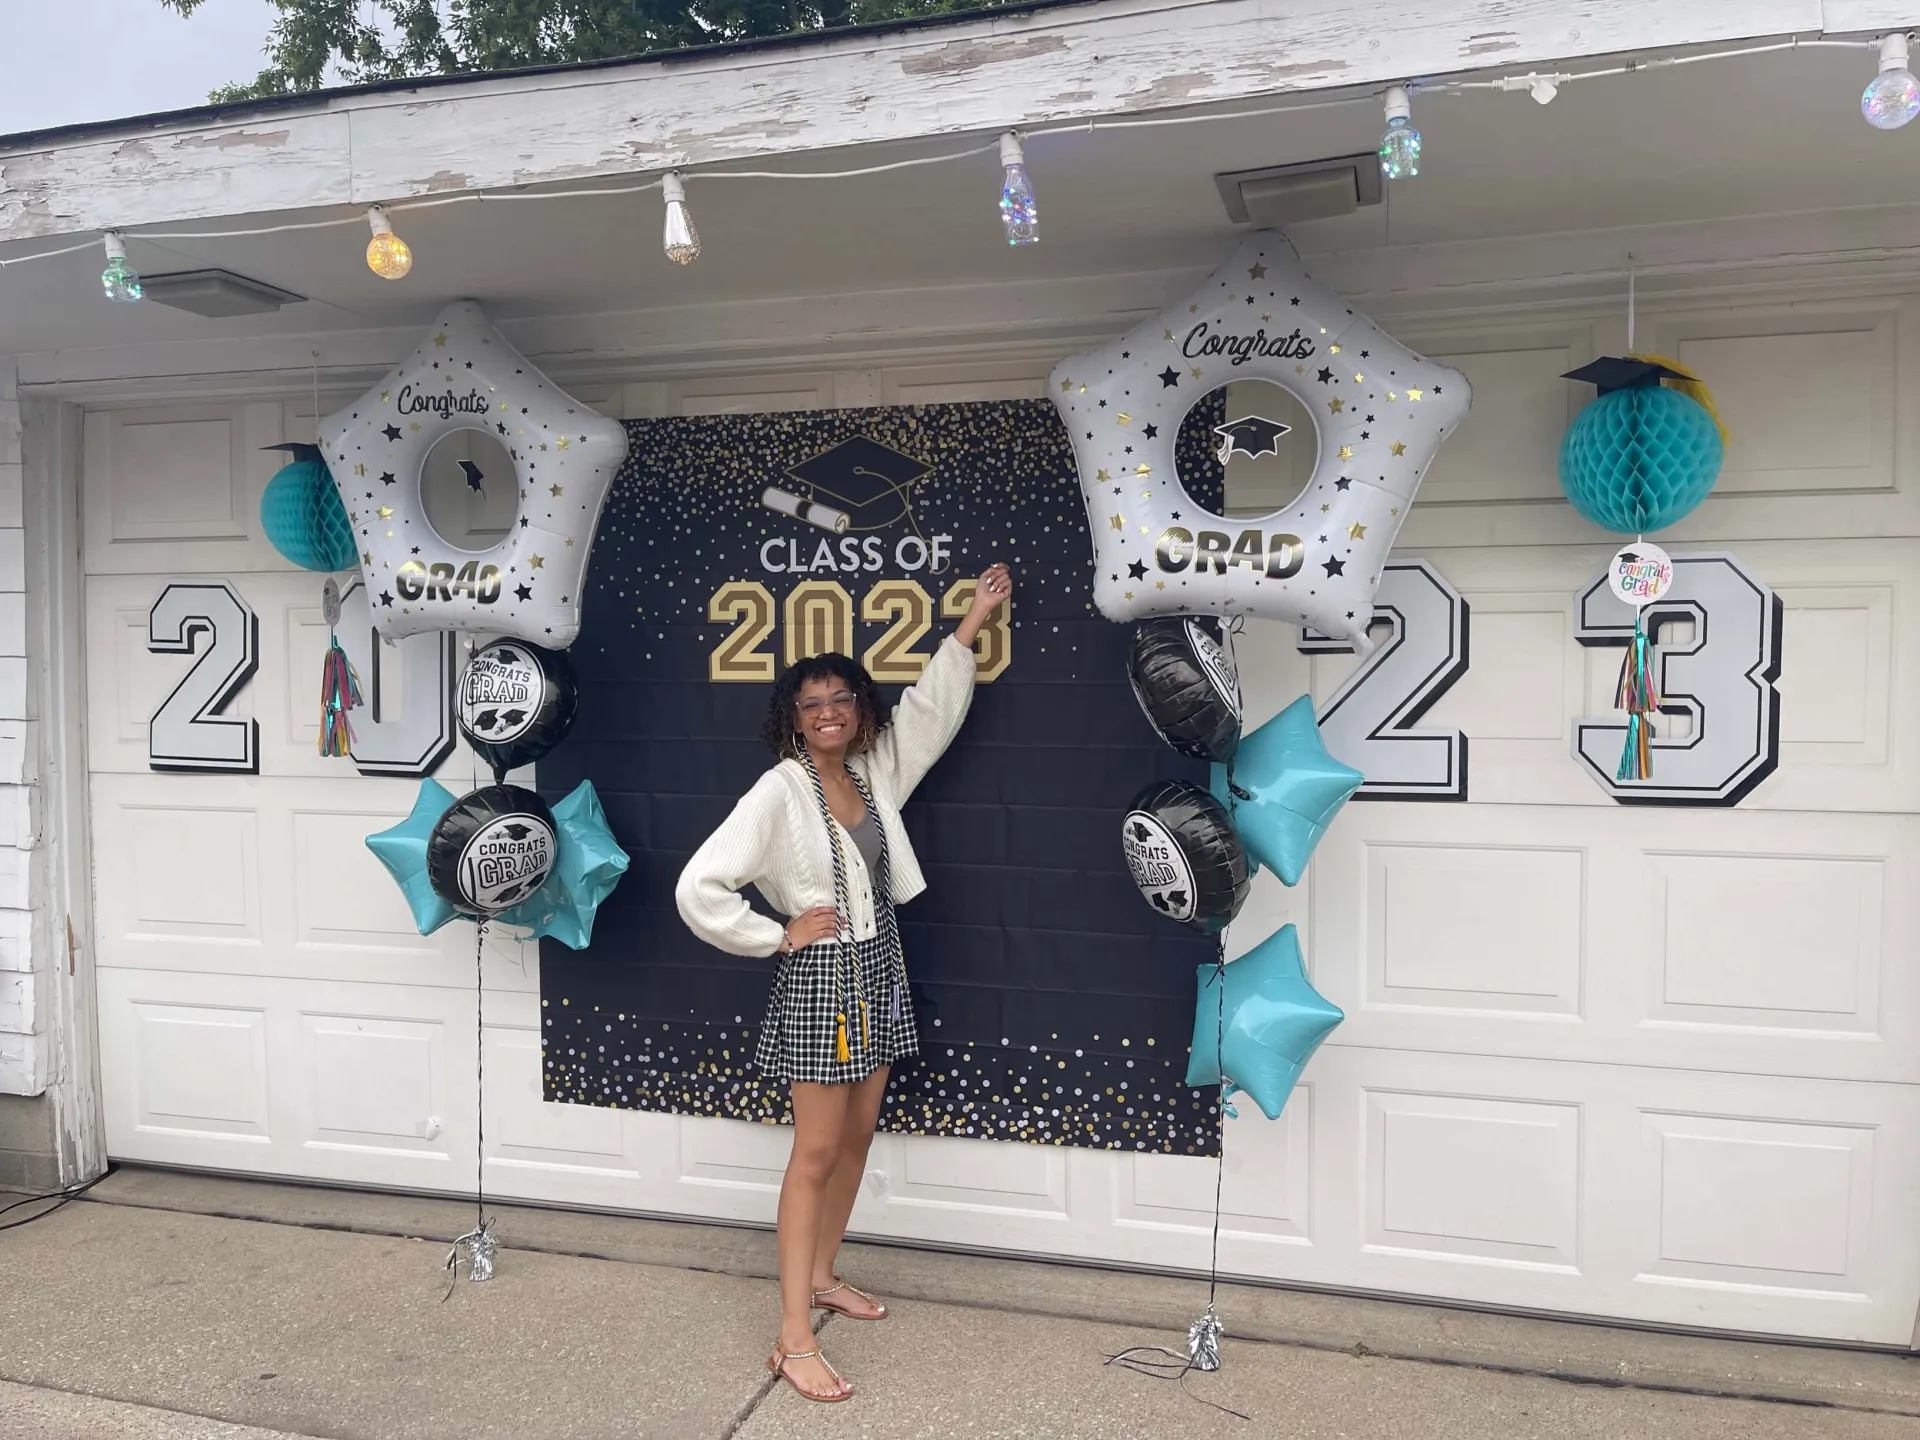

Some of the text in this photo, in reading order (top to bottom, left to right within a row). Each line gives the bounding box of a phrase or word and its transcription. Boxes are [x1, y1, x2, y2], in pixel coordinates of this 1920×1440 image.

[1183, 322, 1316, 366] Congrats
[397, 384, 489, 420] Congrats
[760, 535, 953, 573] CLASS OF
[1155, 527, 1305, 580] GRAD
[395, 559, 502, 606] GRAD
[1621, 575, 1661, 598] Grad
[708, 578, 1012, 684] 2023
[465, 672, 529, 706] GRAD
[479, 836, 546, 856] CONGRATS
[477, 850, 548, 890] GRAD
